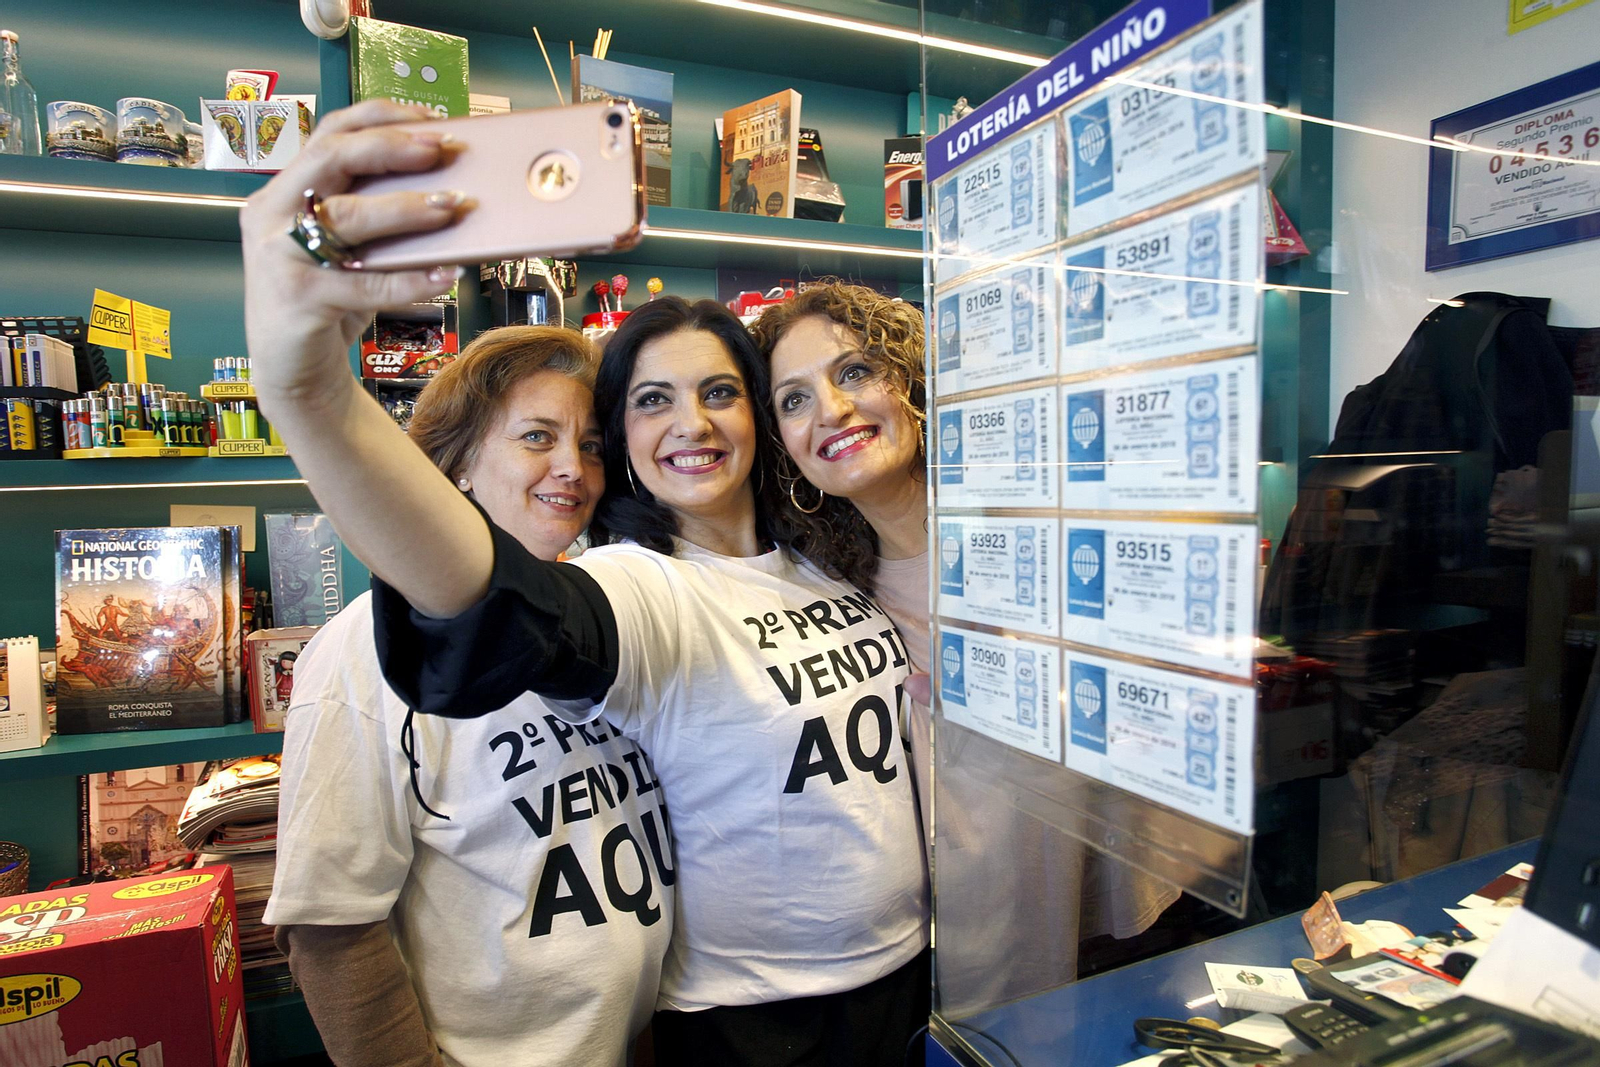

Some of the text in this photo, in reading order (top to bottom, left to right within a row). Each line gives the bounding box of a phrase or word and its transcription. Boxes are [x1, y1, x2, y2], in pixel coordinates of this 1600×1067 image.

[947, 7, 1167, 161] LOTERÍA DEL NIÑO
[414, 90, 449, 102] GUSTAV
[1496, 116, 1593, 150] Segundo Premio
[1514, 109, 1574, 135] DIPLOMA
[964, 162, 1000, 194] 22515
[1494, 163, 1552, 185] VENDIDO
[1116, 234, 1171, 268] 53891
[966, 288, 1002, 313] 81069
[94, 310, 127, 330] CLIPPER
[215, 385, 246, 393] CLIPPER
[1116, 390, 1170, 414] 31877
[970, 411, 1005, 430] 03366
[222, 443, 260, 453] CLIPPER
[84, 540, 137, 553] NATIONAL
[970, 533, 1006, 549] 93923
[1116, 540, 1172, 562] 93515
[72, 555, 206, 582] HISTOA
[971, 646, 1006, 668] 30900
[1118, 681, 1169, 710] 69671
[542, 714, 622, 754] PRE
[148, 876, 202, 892] aspil
[130, 917, 162, 930] MÁS
[43, 997, 65, 1007] BUENO
